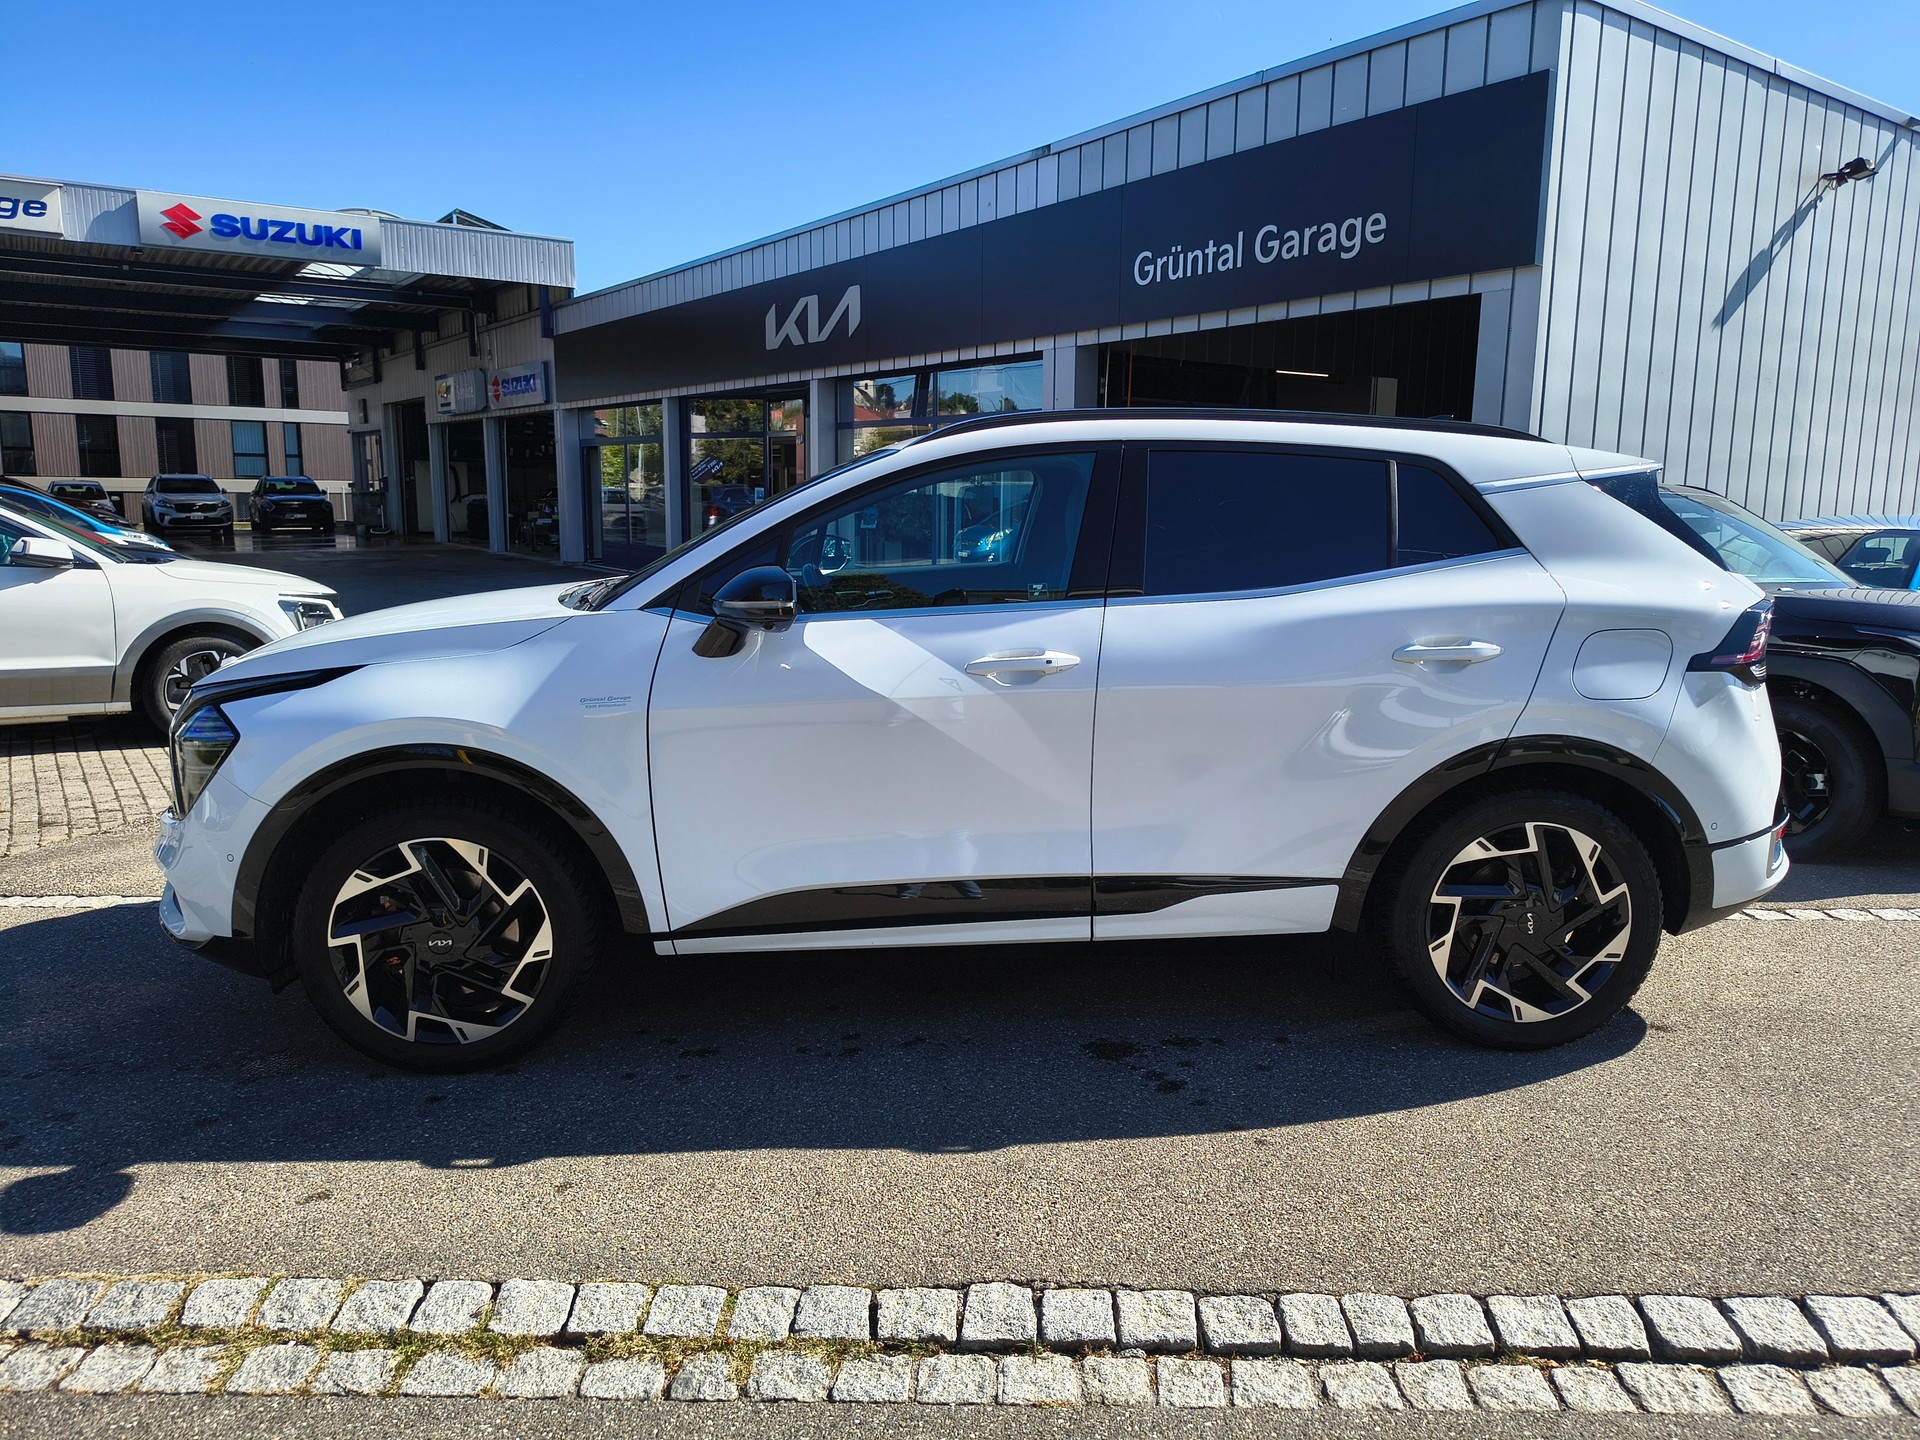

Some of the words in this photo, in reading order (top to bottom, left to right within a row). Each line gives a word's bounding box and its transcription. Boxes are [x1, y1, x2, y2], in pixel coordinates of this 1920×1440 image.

[210, 213, 362, 250] SUZUKI
[1133, 231, 1244, 286] Grüntal
[1254, 212, 1388, 265] Garage
[765, 284, 861, 350] KIA
[501, 373, 537, 397] SUZUKI
[428, 939, 453, 947] KIA
